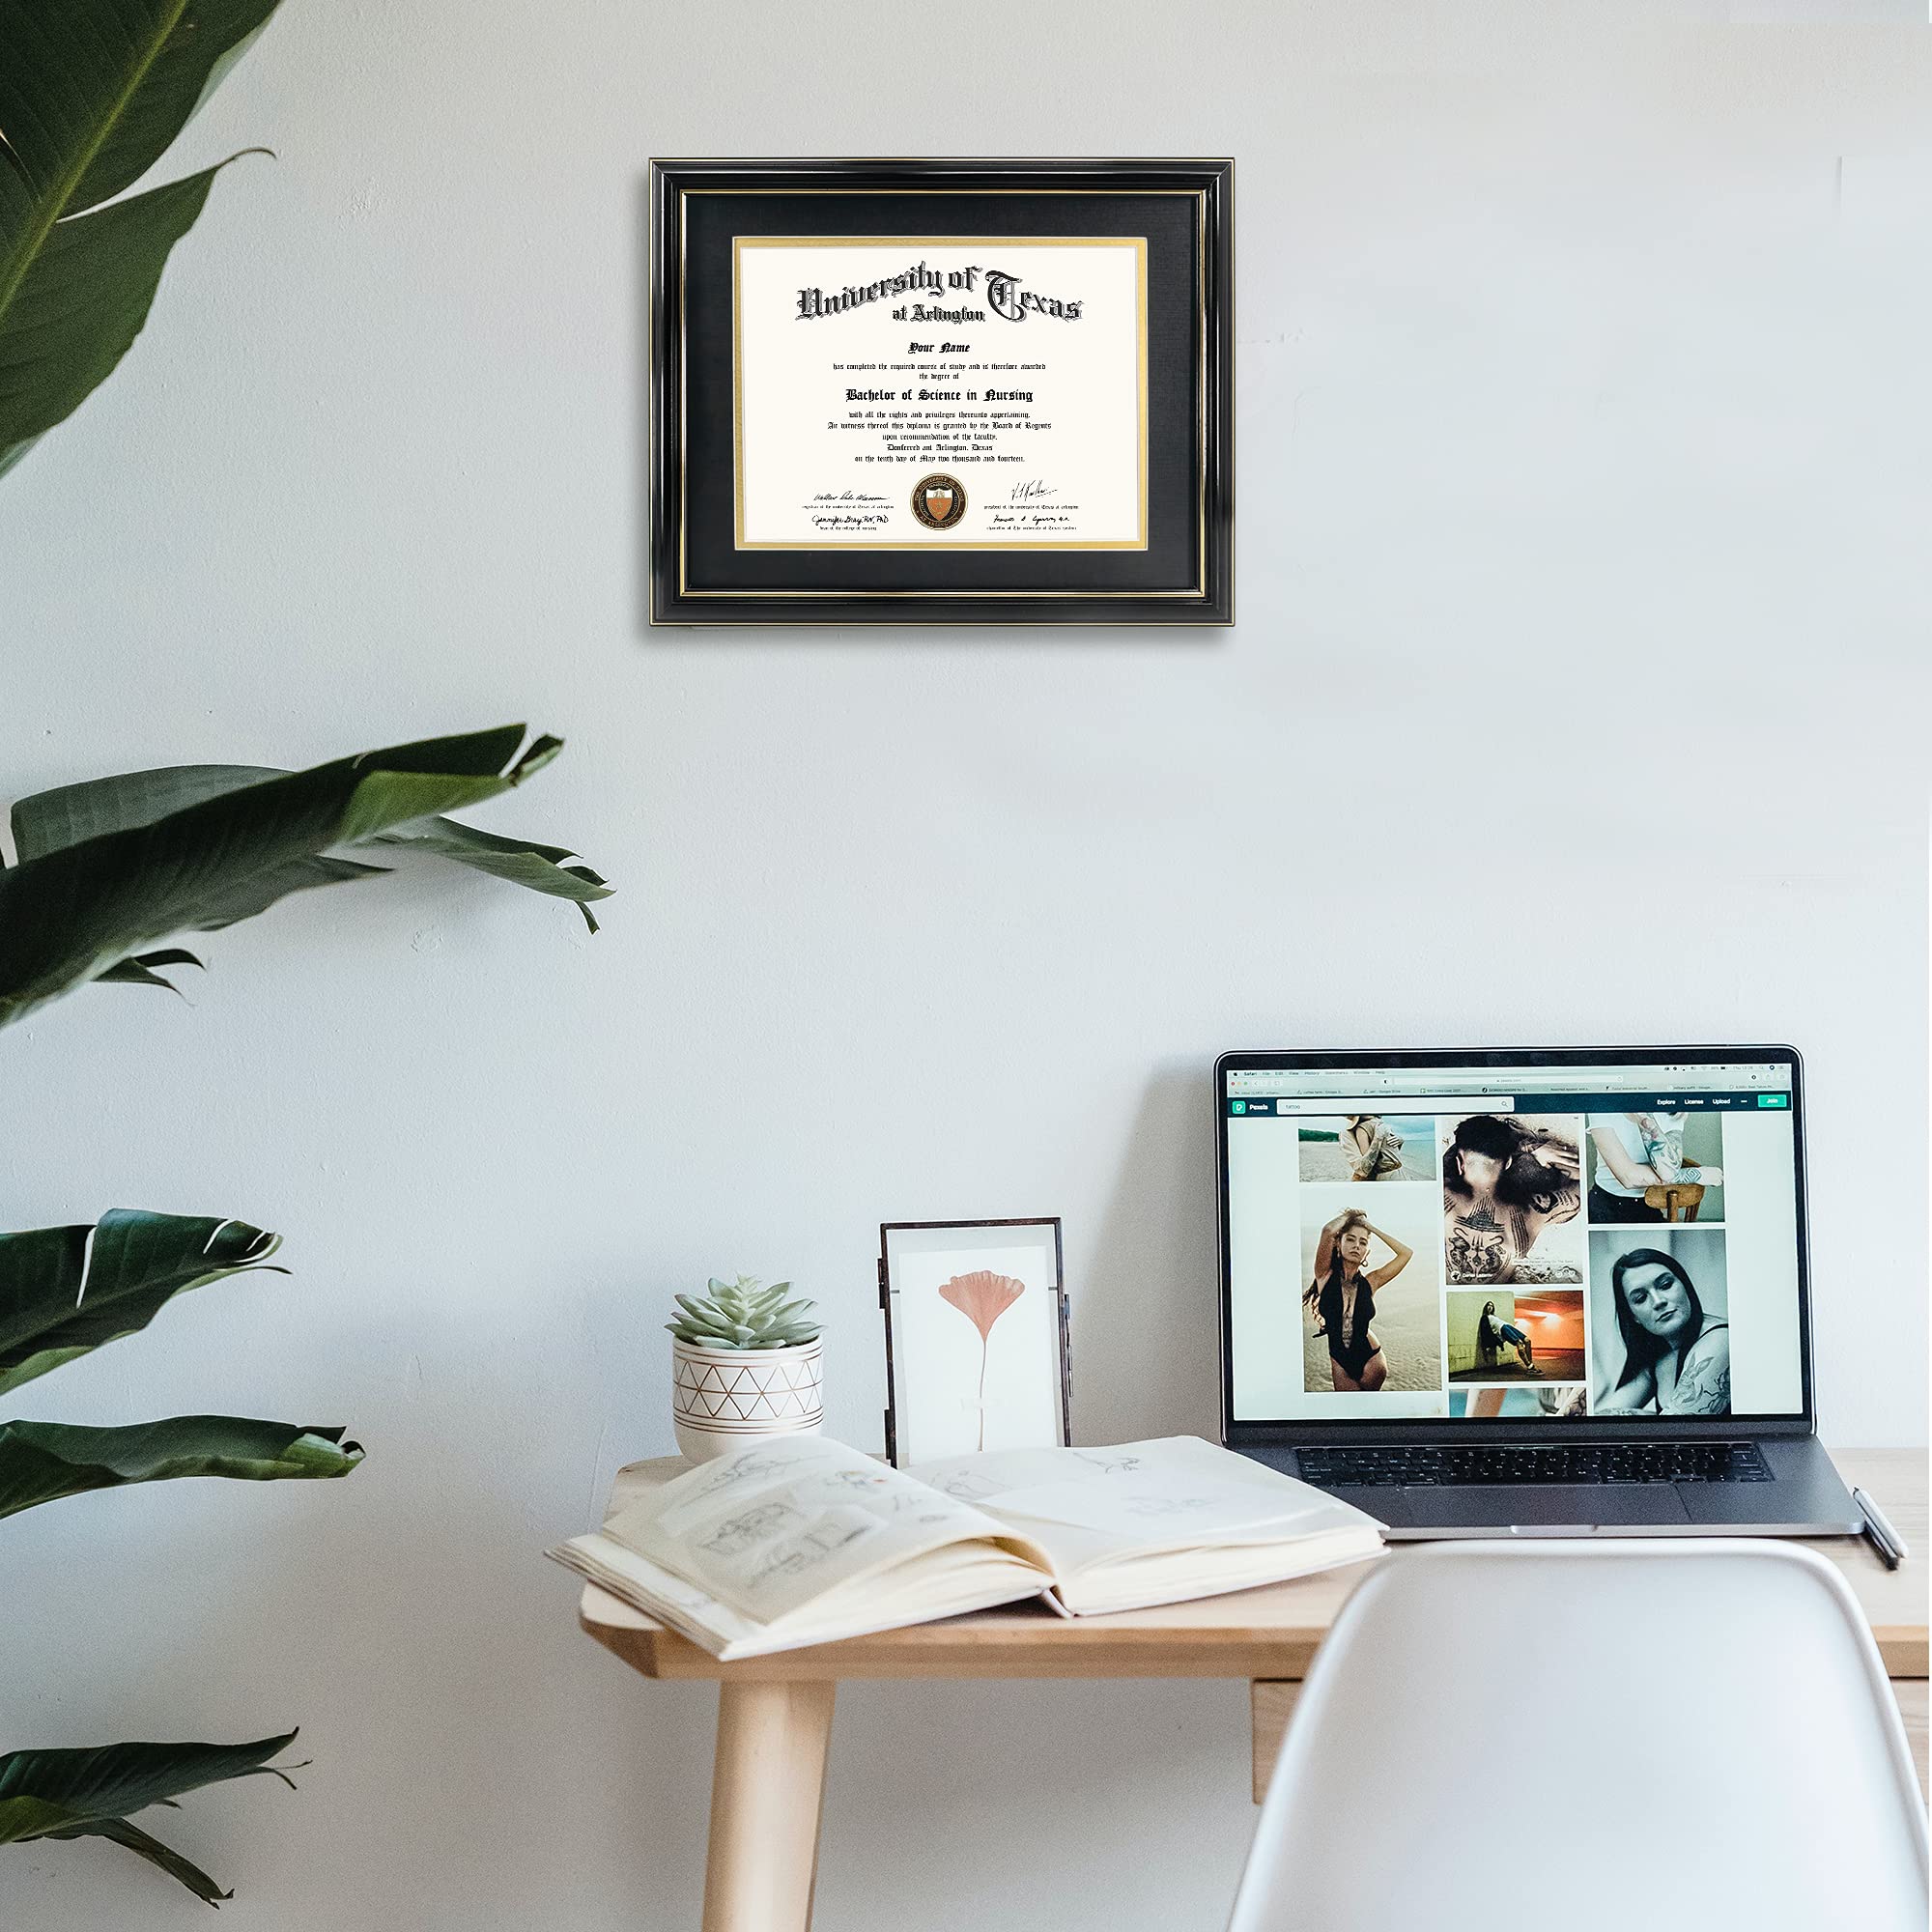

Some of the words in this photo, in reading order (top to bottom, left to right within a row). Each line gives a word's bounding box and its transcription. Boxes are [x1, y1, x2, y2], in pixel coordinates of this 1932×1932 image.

[795, 260, 946, 321] University
[948, 266, 983, 293] of
[984, 270, 1085, 324] Texas
[892, 304, 908, 322] at
[910, 303, 986, 325] Arlington
[908, 342, 935, 354] Your
[939, 342, 970, 353] Name
[846, 389, 895, 402] Bachelor
[902, 389, 912, 400] of
[919, 389, 961, 401] Science
[967, 389, 977, 400] in
[983, 389, 1033, 402] Nursing
